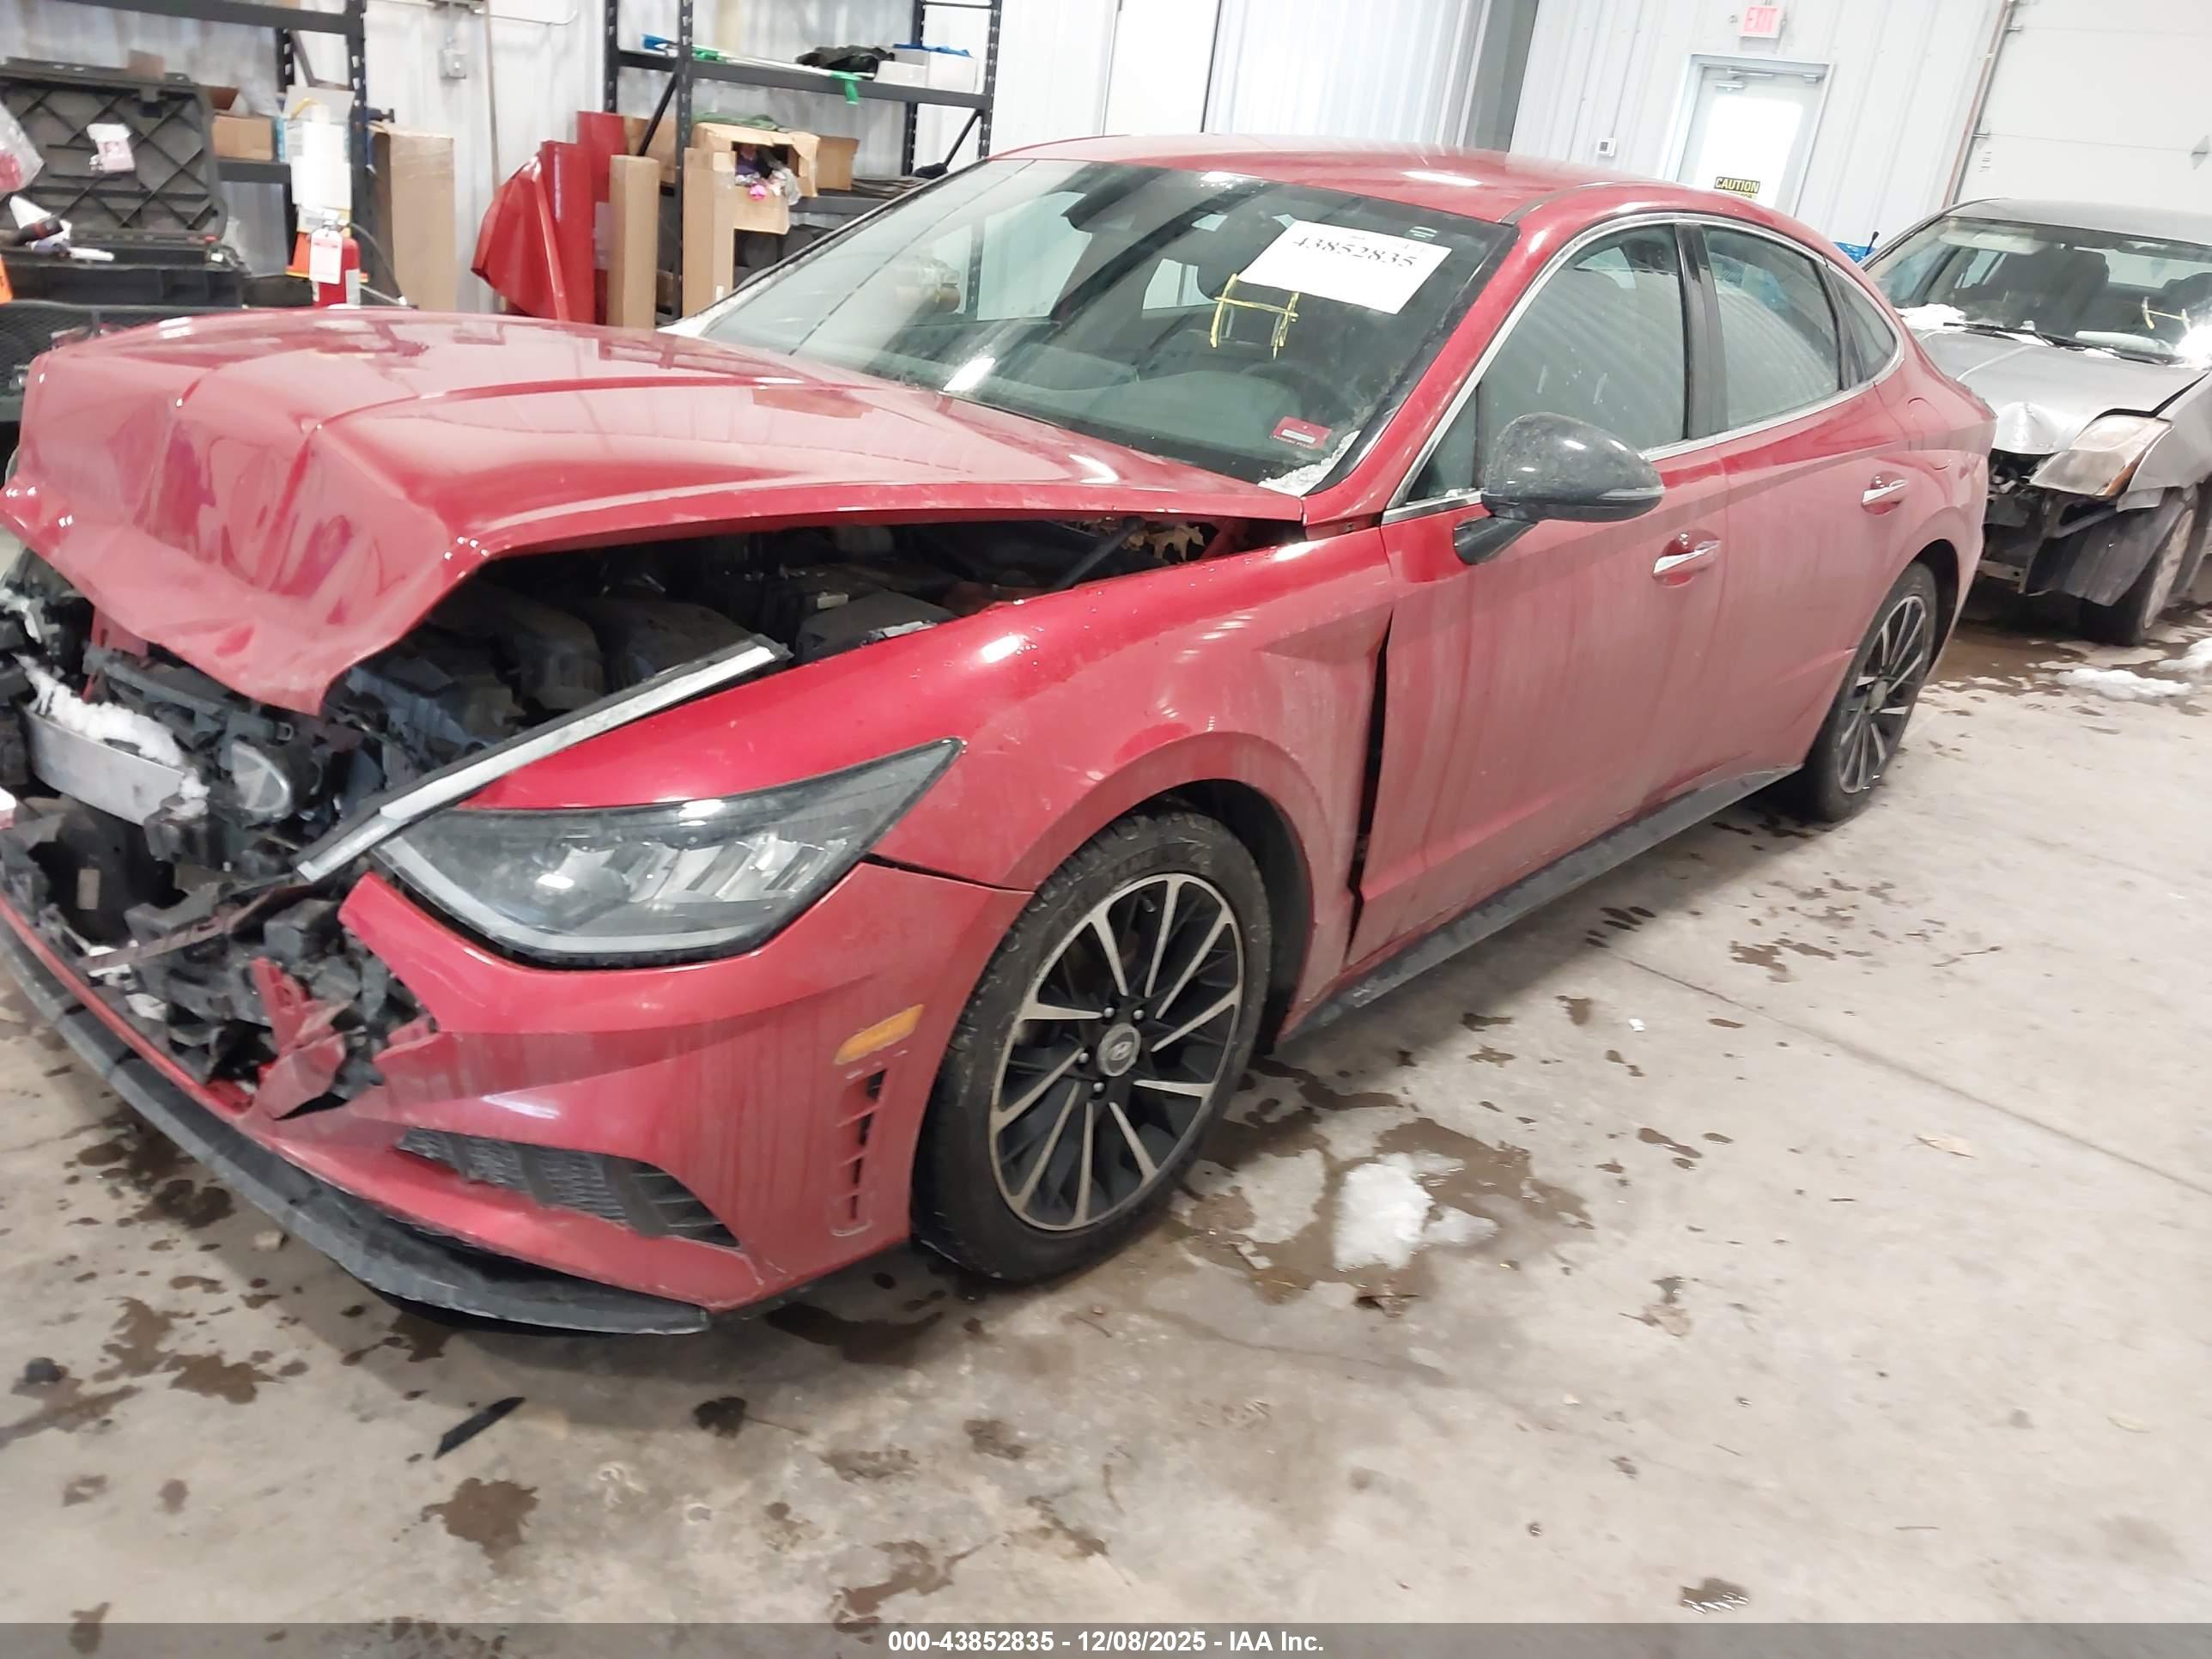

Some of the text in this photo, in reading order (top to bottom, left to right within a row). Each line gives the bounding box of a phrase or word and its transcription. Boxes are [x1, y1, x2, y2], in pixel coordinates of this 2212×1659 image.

[1744, 7, 1778, 33] EXIT
[1717, 177, 1759, 193] CAUTION
[1292, 236, 1418, 268] 43852835
